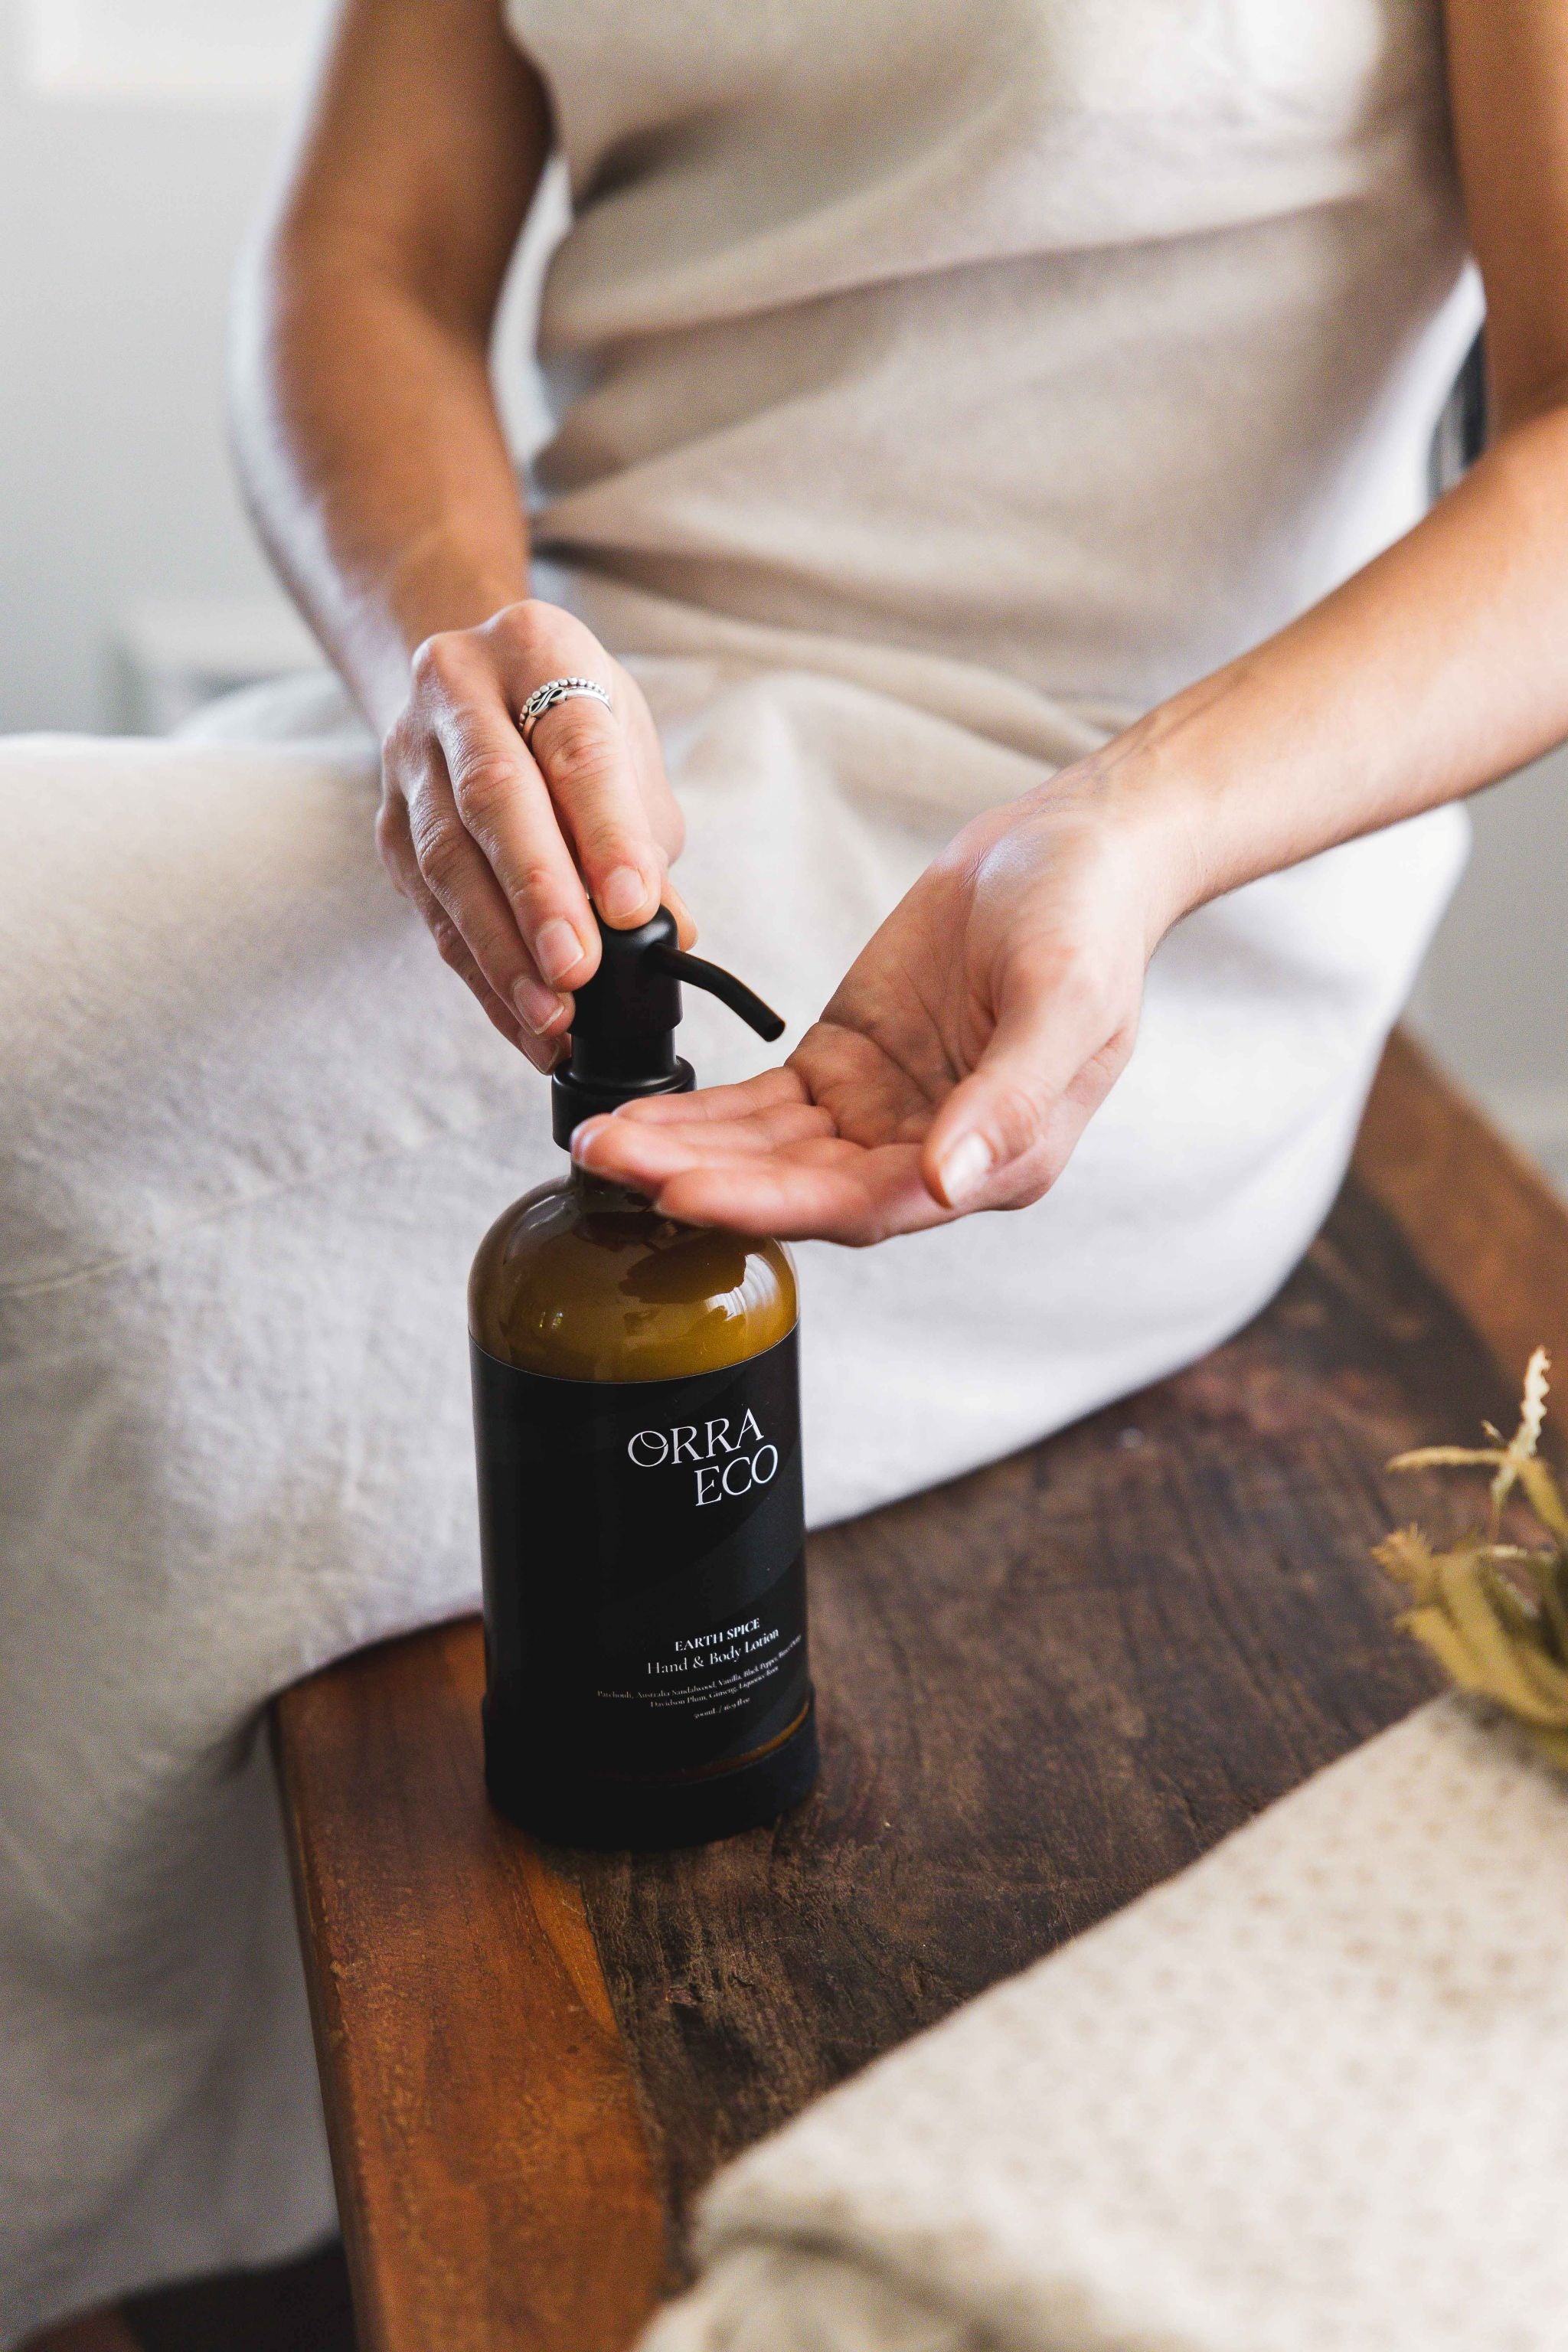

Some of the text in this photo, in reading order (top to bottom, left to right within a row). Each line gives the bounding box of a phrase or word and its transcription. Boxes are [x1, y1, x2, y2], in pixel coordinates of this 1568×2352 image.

[628, 1408, 764, 1467] ORRA
[694, 1444, 778, 1506] ECO
[648, 1657, 688, 1674] Hand
[693, 1655, 704, 1668] &
[710, 1645, 741, 1664] Body
[744, 1628, 779, 1653] Lotion
[675, 1618, 760, 1651] EARTH SPICE
[651, 1699, 685, 1707] Davidson
[687, 1695, 707, 1704] Plum,
[709, 1686, 738, 1698] Ginseng,
[671, 1681, 717, 1696] Sandalwood,
[718, 1674, 743, 1686] Vanilla,
[743, 1666, 760, 1677] Black
